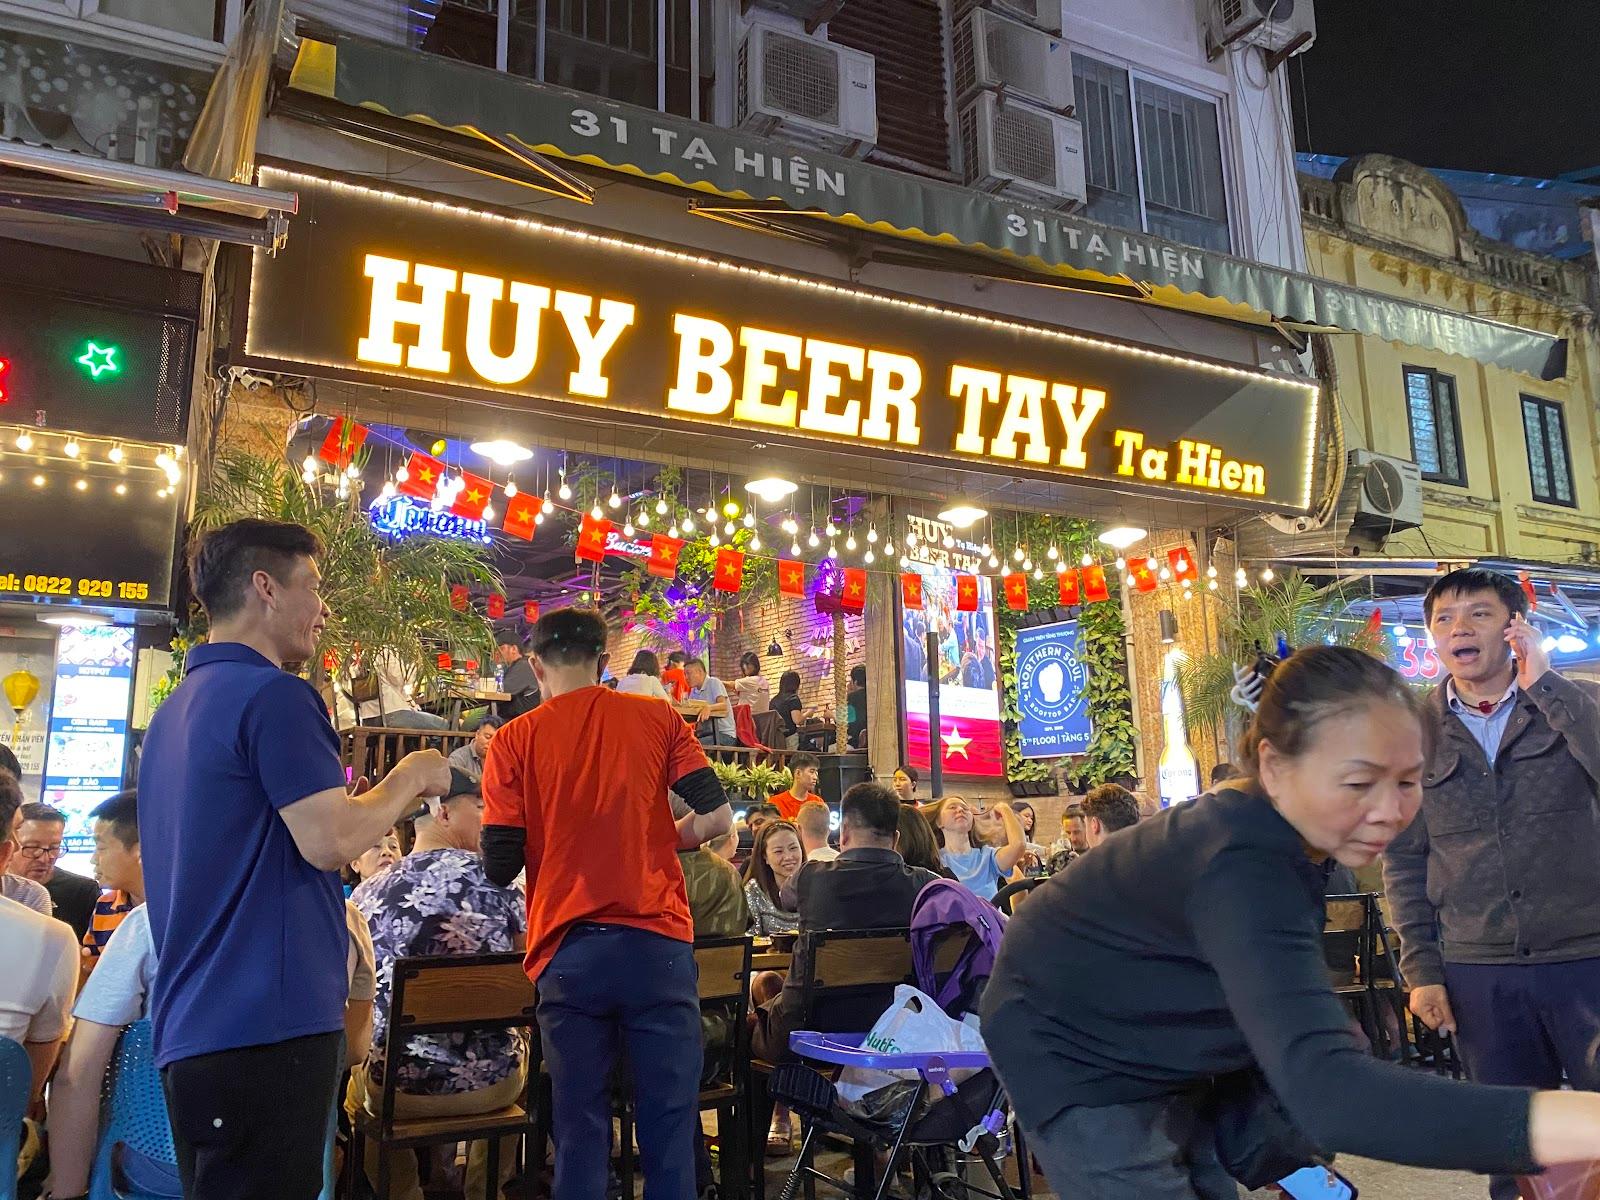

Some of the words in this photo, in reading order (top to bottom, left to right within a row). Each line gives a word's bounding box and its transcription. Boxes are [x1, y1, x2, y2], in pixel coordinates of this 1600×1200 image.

[570, 109, 627, 145] 31
[652, 127, 717, 170] TẠ
[735, 147, 846, 196] HIỆN
[1007, 213, 1047, 243] 31
[1062, 226, 1112, 261] TẠ
[1122, 236, 1204, 280] HIỆN
[356, 254, 636, 399] HUY
[667, 312, 922, 446] BEER
[949, 364, 1107, 470] TAY
[1114, 428, 1168, 481] Ta
[1176, 440, 1266, 496] Hien
[24, 574, 72, 595] 0822
[78, 578, 113, 598] 929
[118, 582, 149, 600] 155
[1021, 647, 1062, 690] NORTHERN
[1063, 652, 1082, 682] SOUL
[1029, 702, 1062, 718] ROOFTOP
[1033, 735, 1056, 746] FLOOR
[1084, 732, 1090, 741] 5
